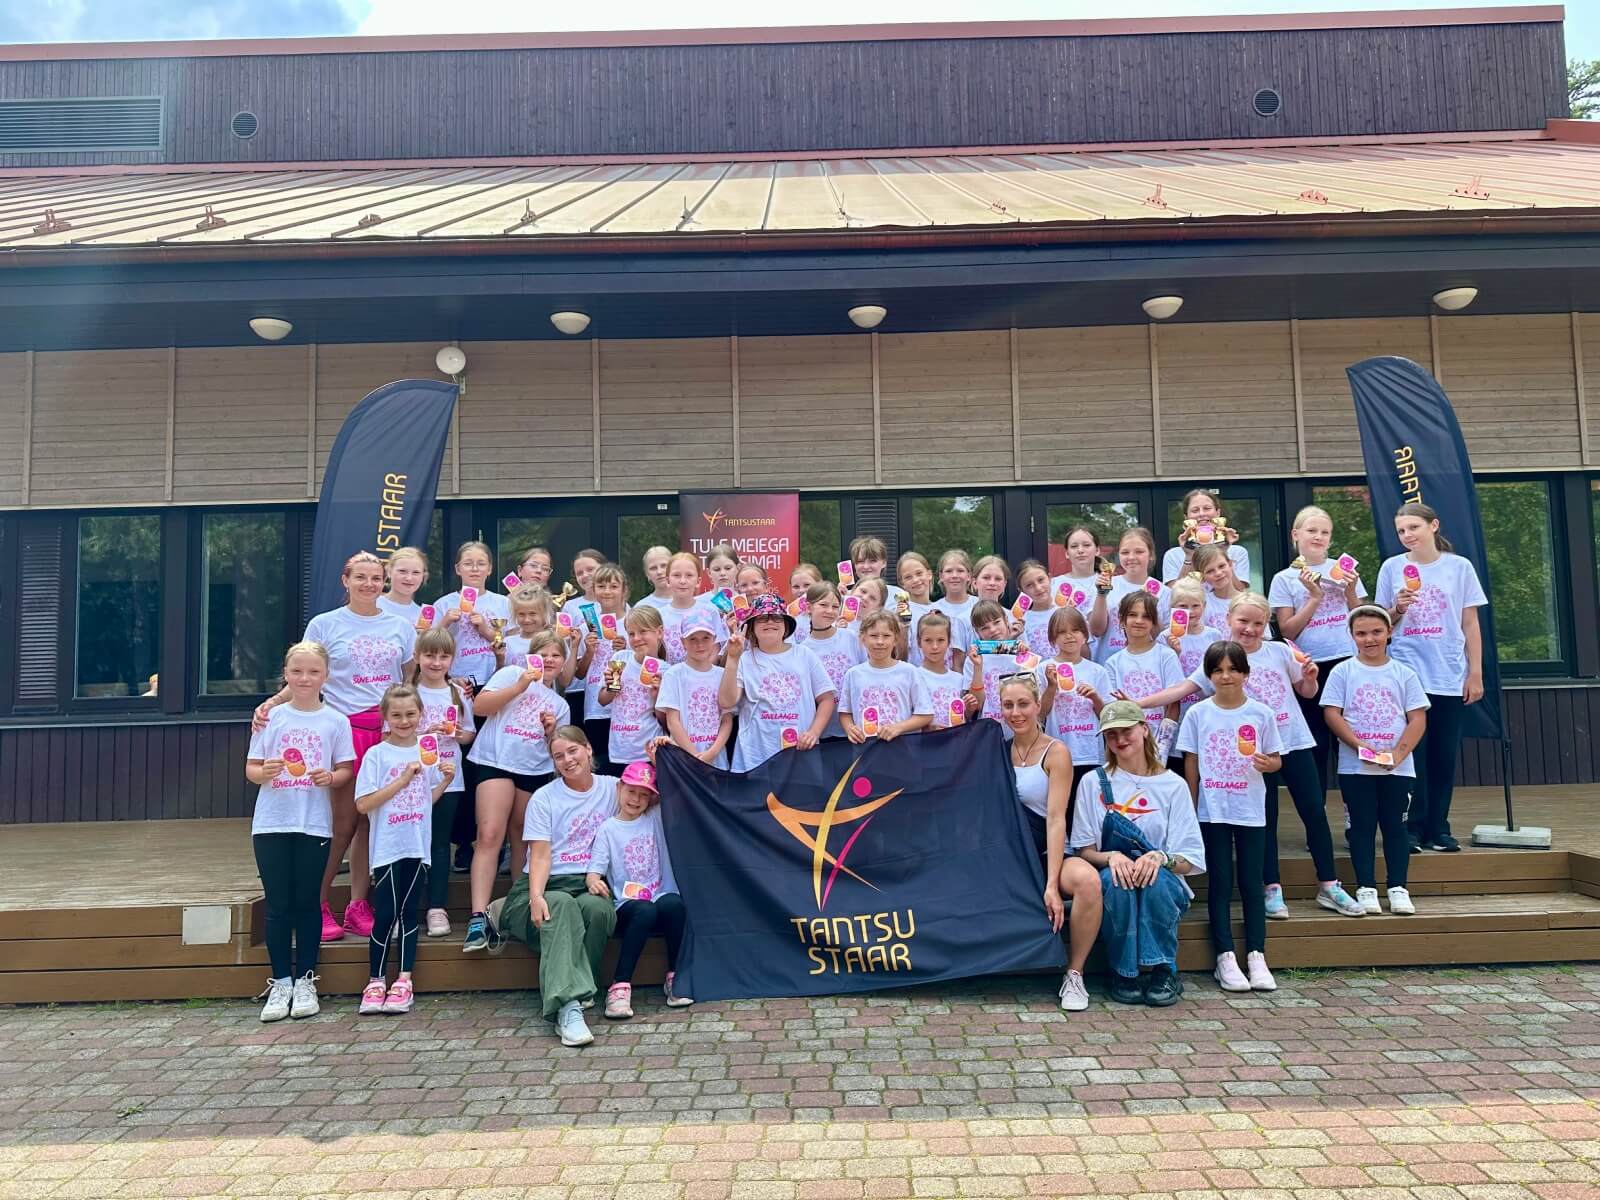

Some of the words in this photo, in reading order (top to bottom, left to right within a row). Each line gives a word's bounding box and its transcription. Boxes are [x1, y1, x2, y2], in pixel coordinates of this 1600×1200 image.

[376, 473, 407, 563] USTAAR
[725, 518, 775, 527] TANTSUSTAAR
[732, 537, 789, 553] MEIEGA
[699, 554, 781, 570] TSIMA!
[790, 909, 916, 945] TANTSU
[808, 943, 912, 975] STAAR
